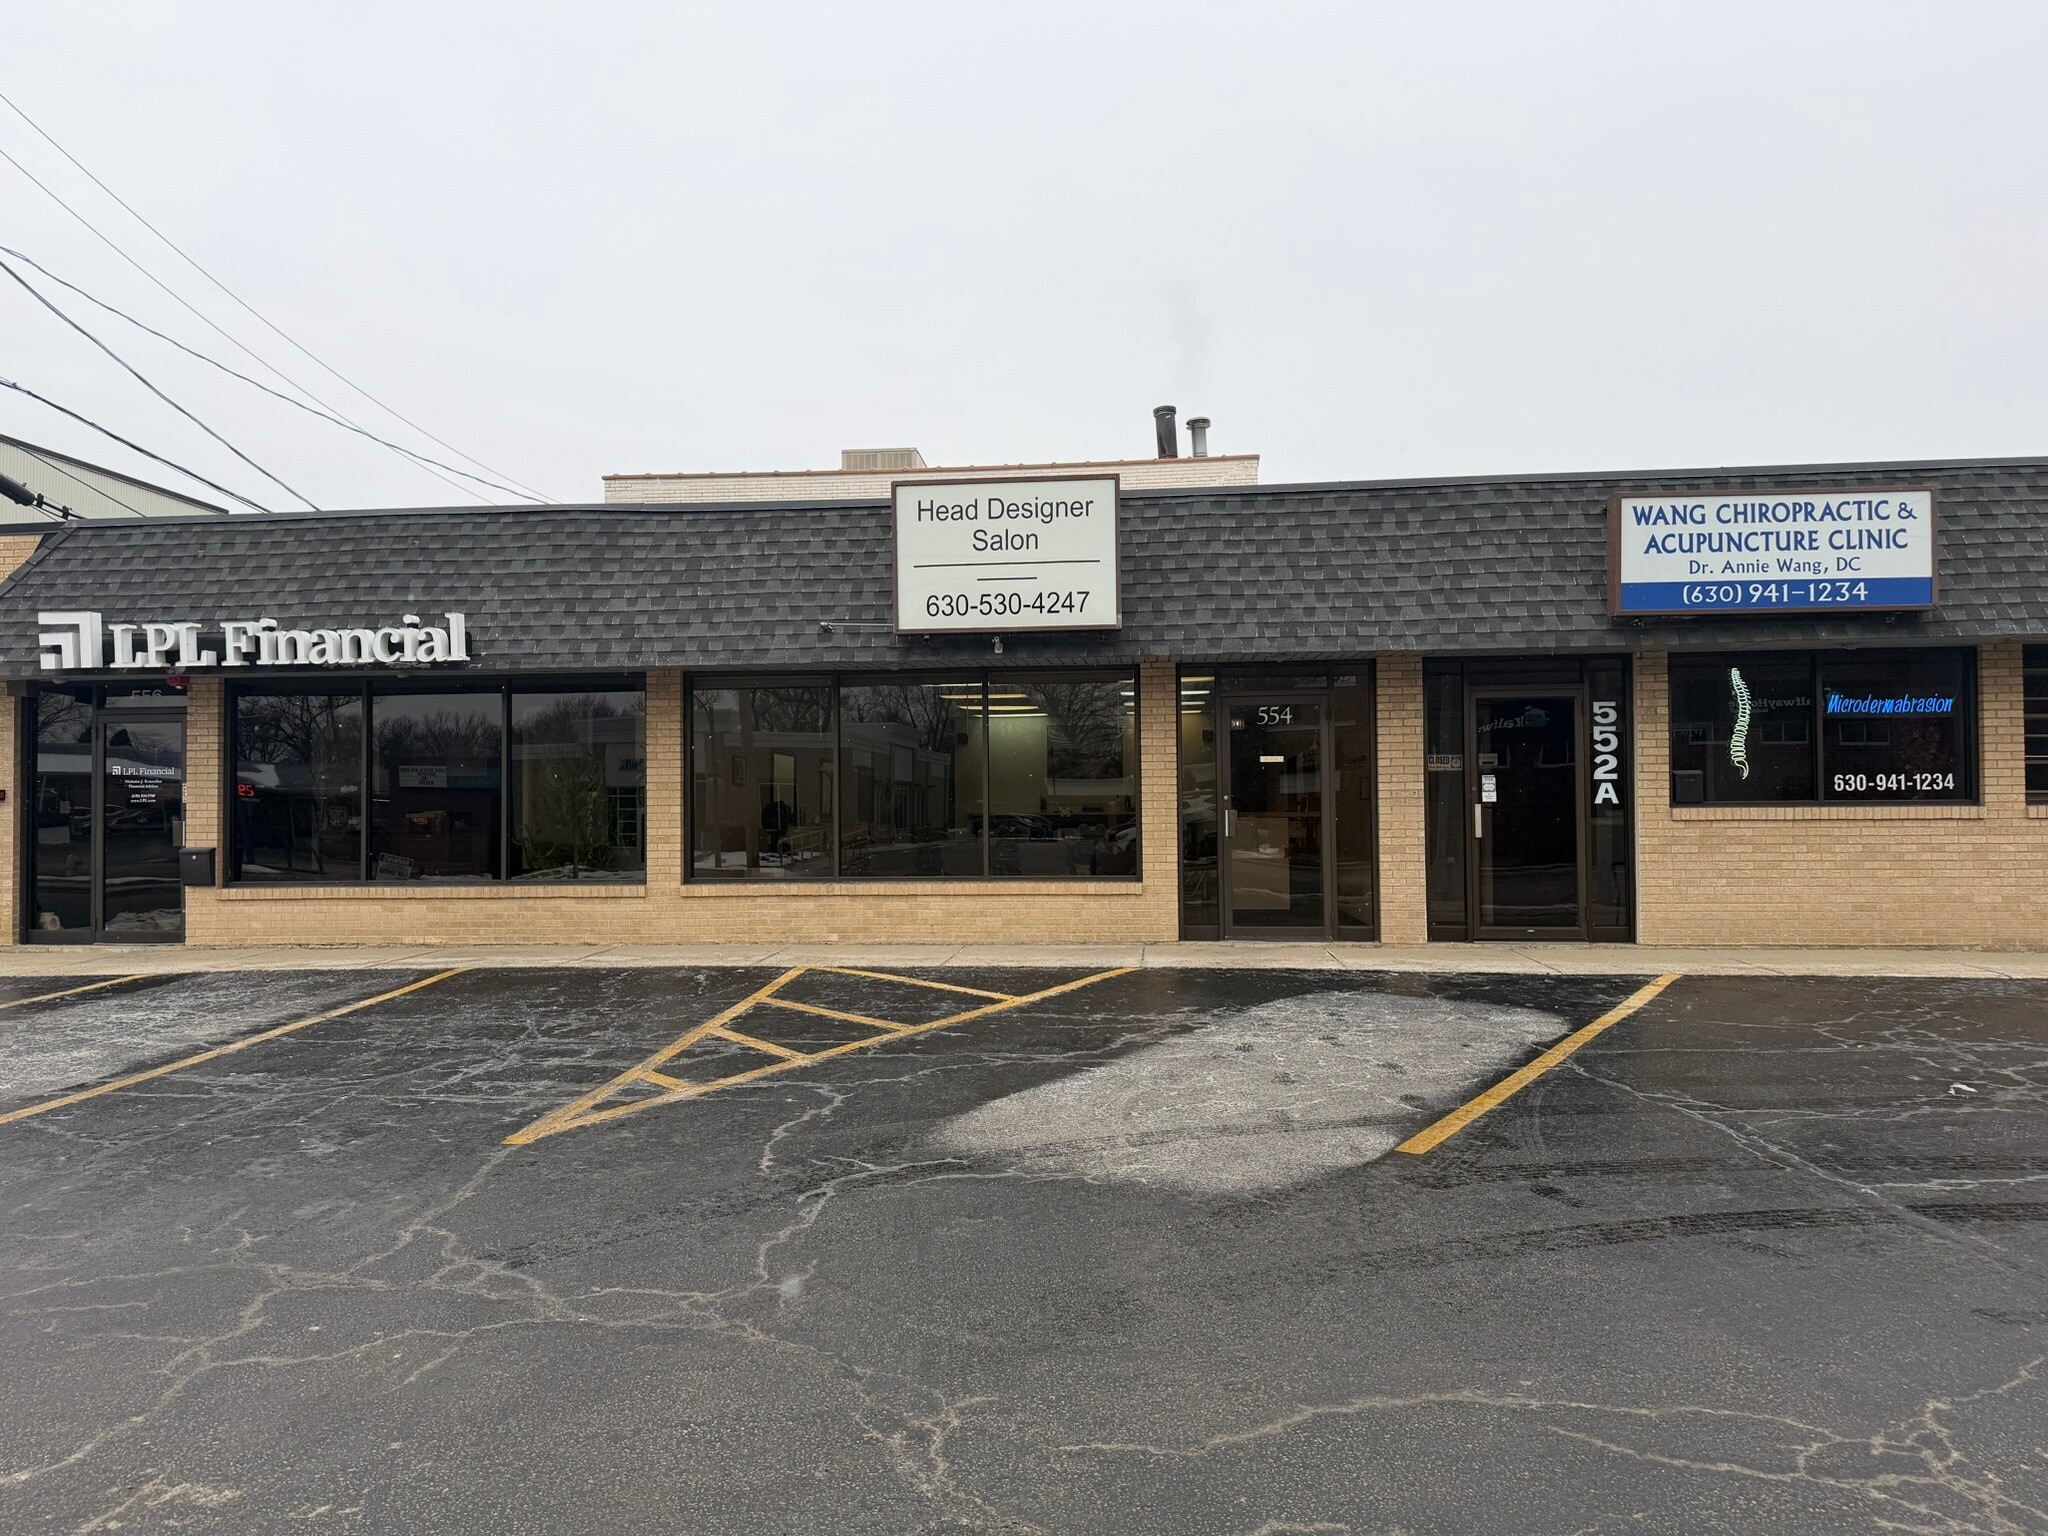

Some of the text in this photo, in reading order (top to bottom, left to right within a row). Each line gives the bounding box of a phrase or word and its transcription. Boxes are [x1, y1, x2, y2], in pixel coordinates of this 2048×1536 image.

[917, 496, 1094, 525] Head Designer
[1632, 499, 1918, 526] WANG CHIROPRACTIC &
[972, 528, 1039, 551] Salon
[1643, 528, 1908, 555] ACUPUNCTURE CLINIC
[1689, 556, 1861, 575] Dr. Annie Wang, DC
[926, 590, 1090, 617] 630-530-4247
[1683, 581, 1869, 605] (630) 941-1234
[108, 612, 471, 668] LPL Financial
[1256, 705, 1293, 725] 554
[1428, 755, 1450, 765] CLOSED
[1592, 701, 1620, 805] 552A
[122, 766, 175, 776] LPL Financial
[1834, 773, 1955, 792] 630-941-1234
